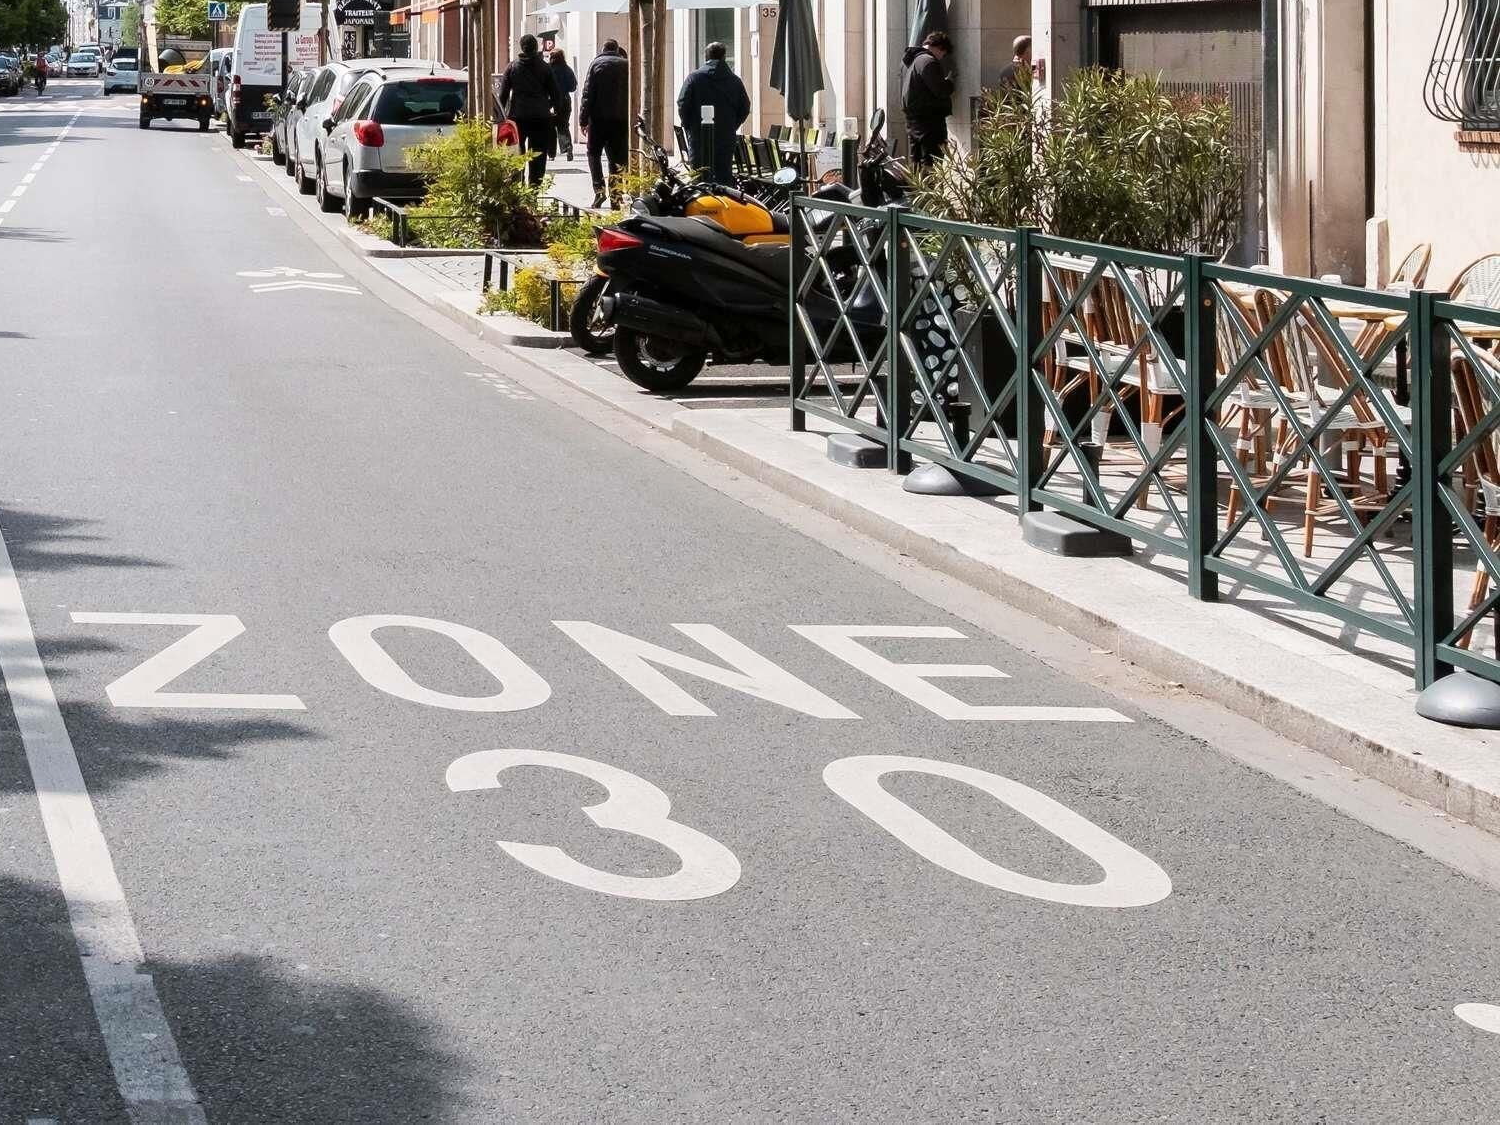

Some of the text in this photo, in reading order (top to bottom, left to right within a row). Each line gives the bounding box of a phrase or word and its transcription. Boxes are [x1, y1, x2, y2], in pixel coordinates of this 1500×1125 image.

[762, 7, 777, 18] 35
[70, 611, 1134, 724] ZONE
[444, 747, 1173, 909] 30
